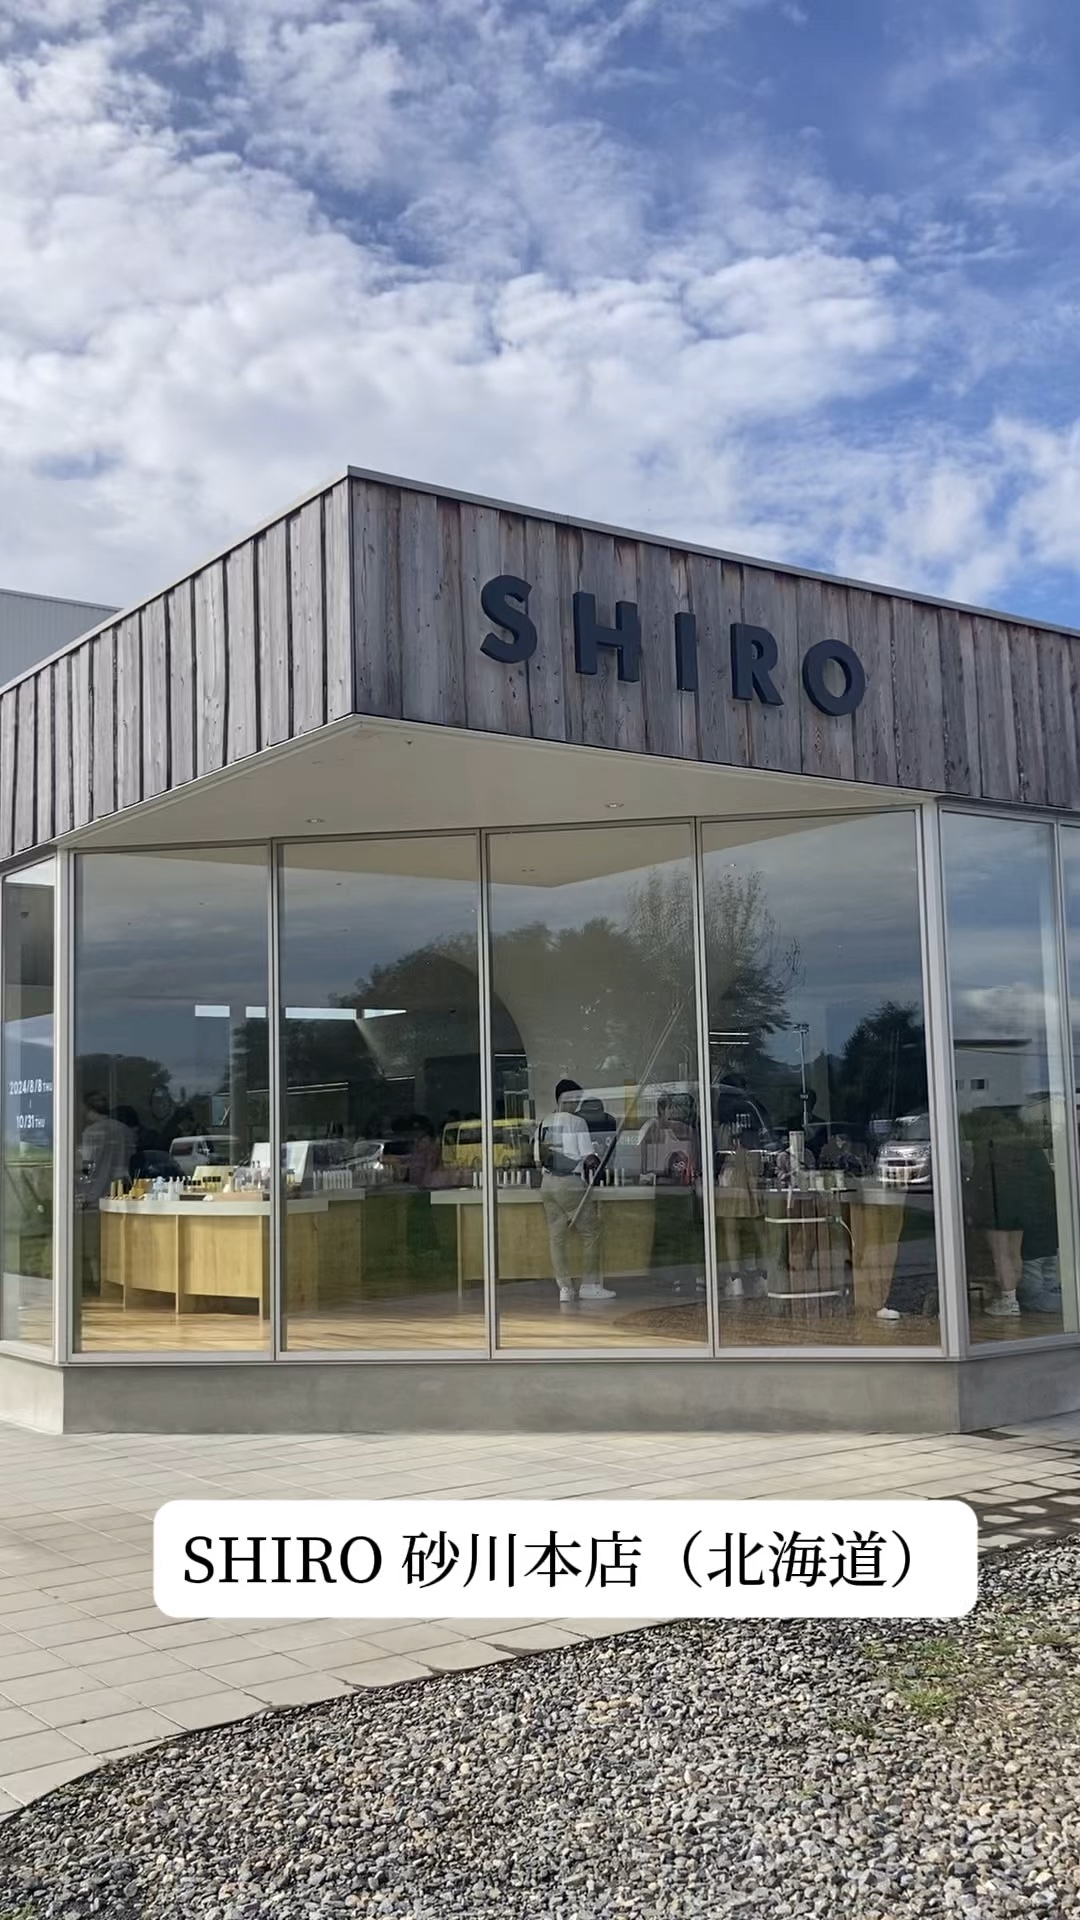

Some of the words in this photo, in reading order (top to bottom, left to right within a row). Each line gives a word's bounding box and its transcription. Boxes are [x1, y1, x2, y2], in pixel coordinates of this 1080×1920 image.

[480, 574, 867, 717] SHIRO
[9, 1079, 42, 1095] 2024/8/8
[16, 1114, 35, 1129] 10/31
